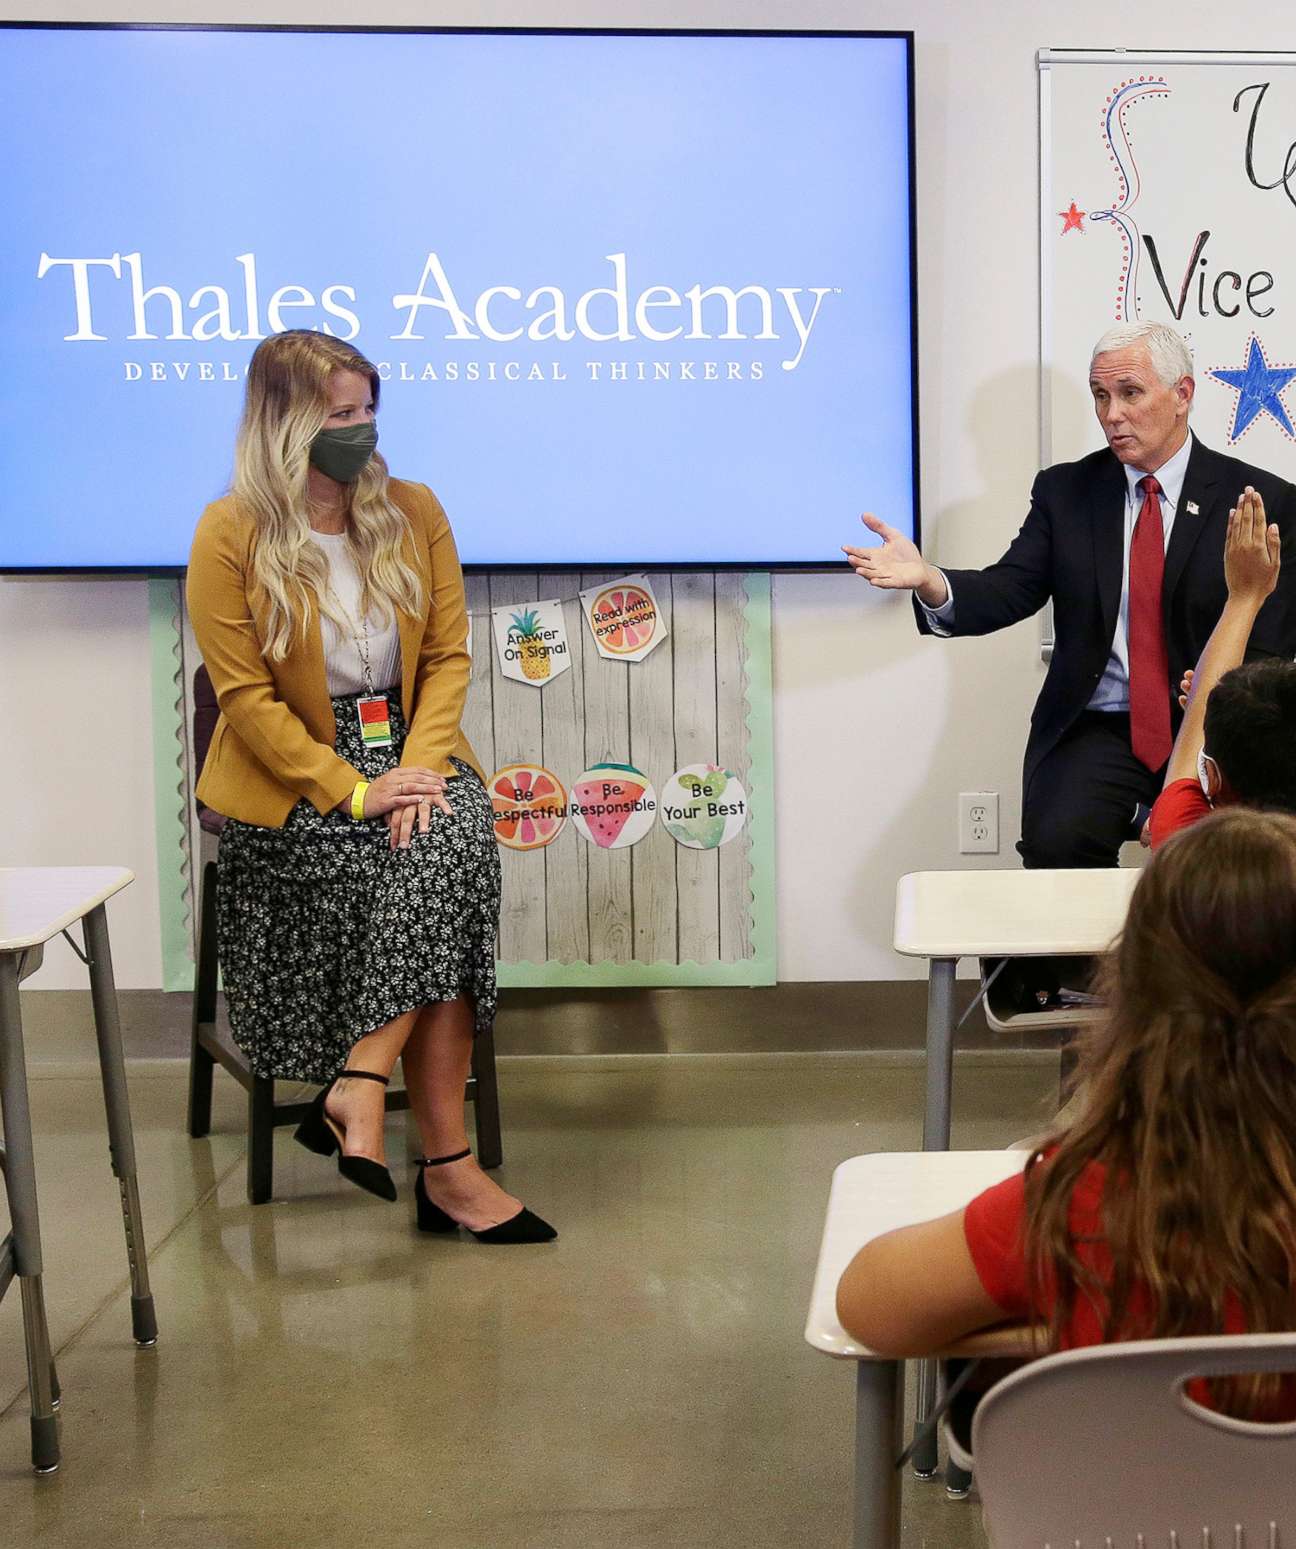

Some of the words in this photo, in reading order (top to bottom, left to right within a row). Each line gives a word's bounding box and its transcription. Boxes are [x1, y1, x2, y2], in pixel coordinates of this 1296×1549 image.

[1142, 230, 1274, 320] Vice
[37, 252, 361, 343] Thales
[390, 252, 831, 371] Academy
[124, 362, 249, 381] DEVEL
[378, 362, 567, 381] CLASSICAL
[586, 361, 764, 380] THINKERS
[593, 607, 623, 625] Read
[625, 599, 650, 617] with
[596, 611, 657, 636] expression
[507, 629, 559, 646] Answer
[504, 649, 524, 661] On
[527, 641, 567, 659] Signal
[514, 788, 534, 802] Be
[602, 783, 623, 797] Be
[692, 783, 713, 798] Be
[493, 804, 568, 825] espectful
[571, 799, 655, 817] Responsible
[664, 806, 701, 821] Your
[707, 801, 744, 817] Best
